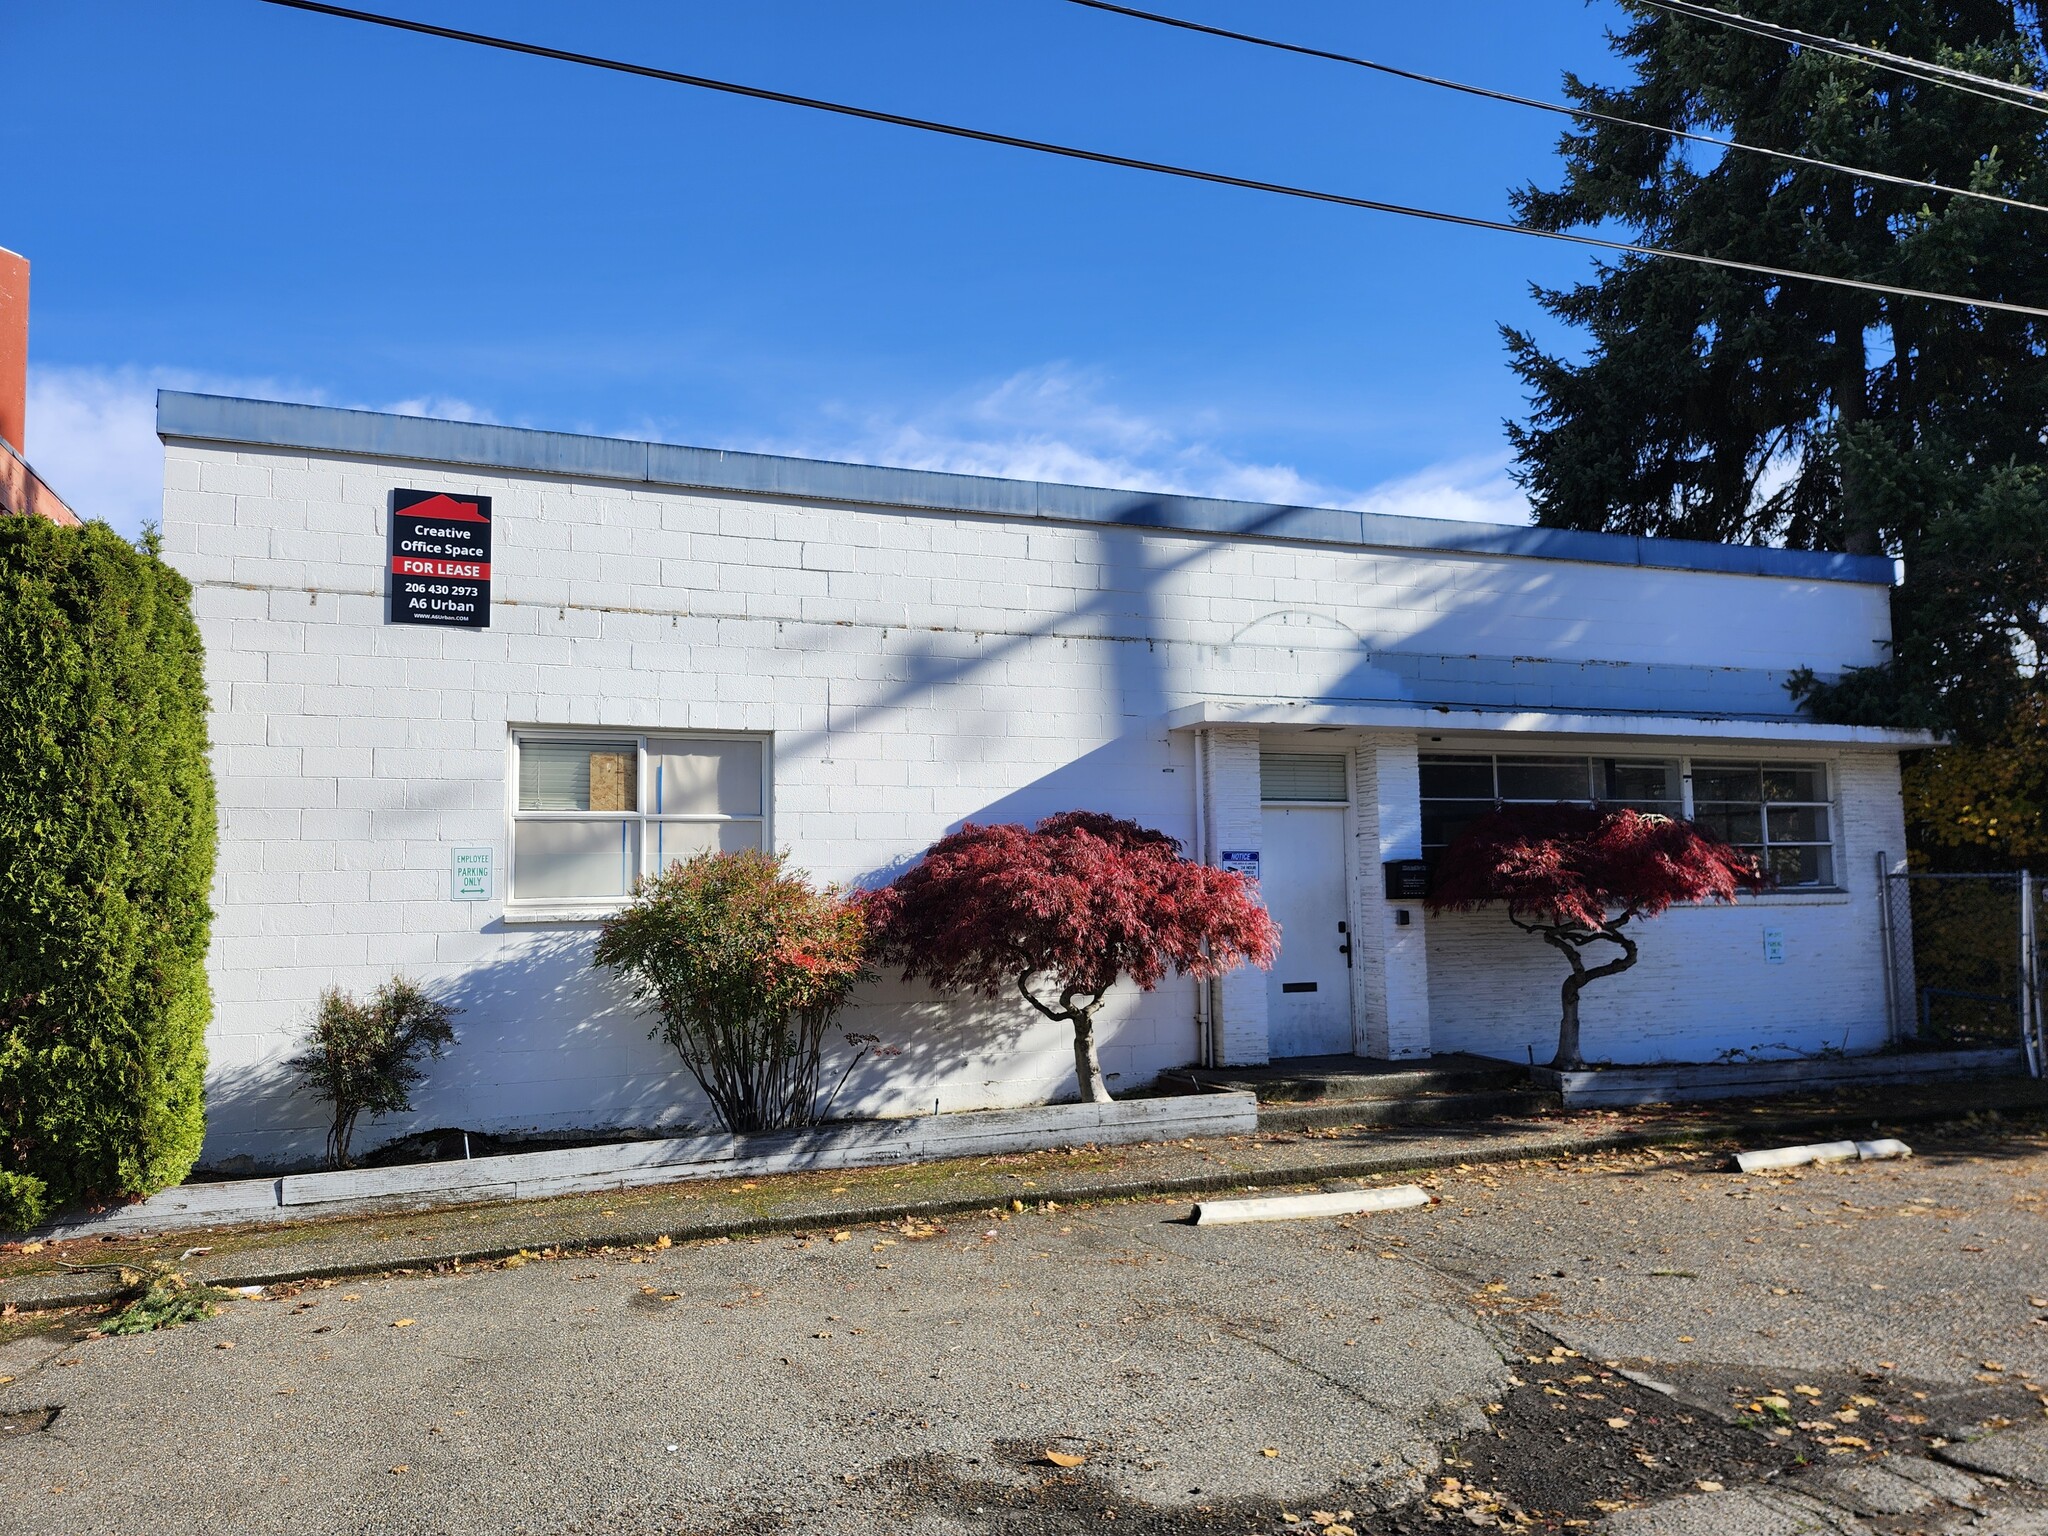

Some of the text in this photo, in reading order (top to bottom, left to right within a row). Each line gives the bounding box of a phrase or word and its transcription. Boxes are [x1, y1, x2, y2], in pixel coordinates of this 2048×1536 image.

[414, 525, 471, 539] Creative
[401, 540, 484, 557] Office Space
[404, 560, 480, 577] FOR LEASE
[405, 582, 478, 597] 206 430 2973
[408, 597, 475, 612] A6 Urban
[457, 855, 489, 863] EMPLOYEE
[457, 868, 488, 877] PARKING
[463, 877, 482, 886] ONLY
